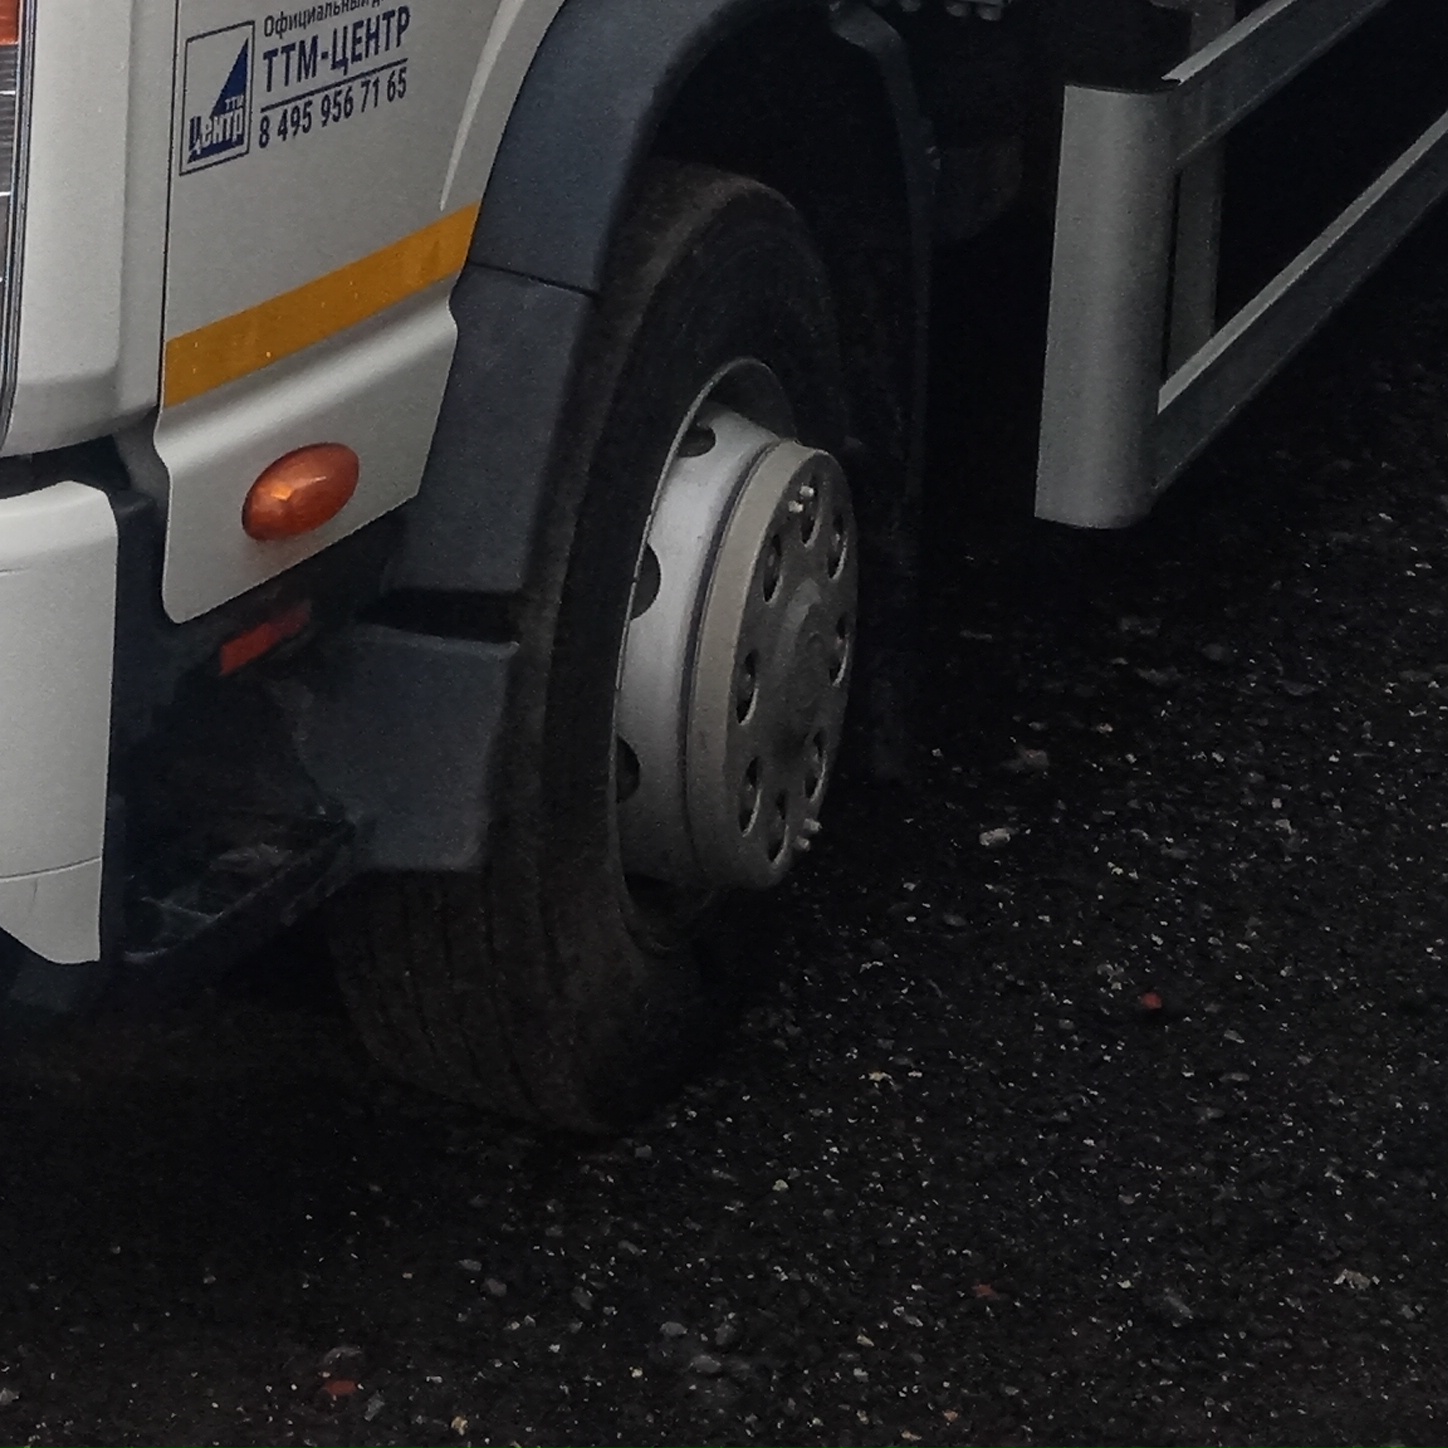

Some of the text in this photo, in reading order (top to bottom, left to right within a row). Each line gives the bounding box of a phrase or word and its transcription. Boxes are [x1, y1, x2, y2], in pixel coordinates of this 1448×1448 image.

[262, 5, 411, 92] ТТМ-ЦЕНТР
[258, 66, 408, 149] 8 495 956 71 65
